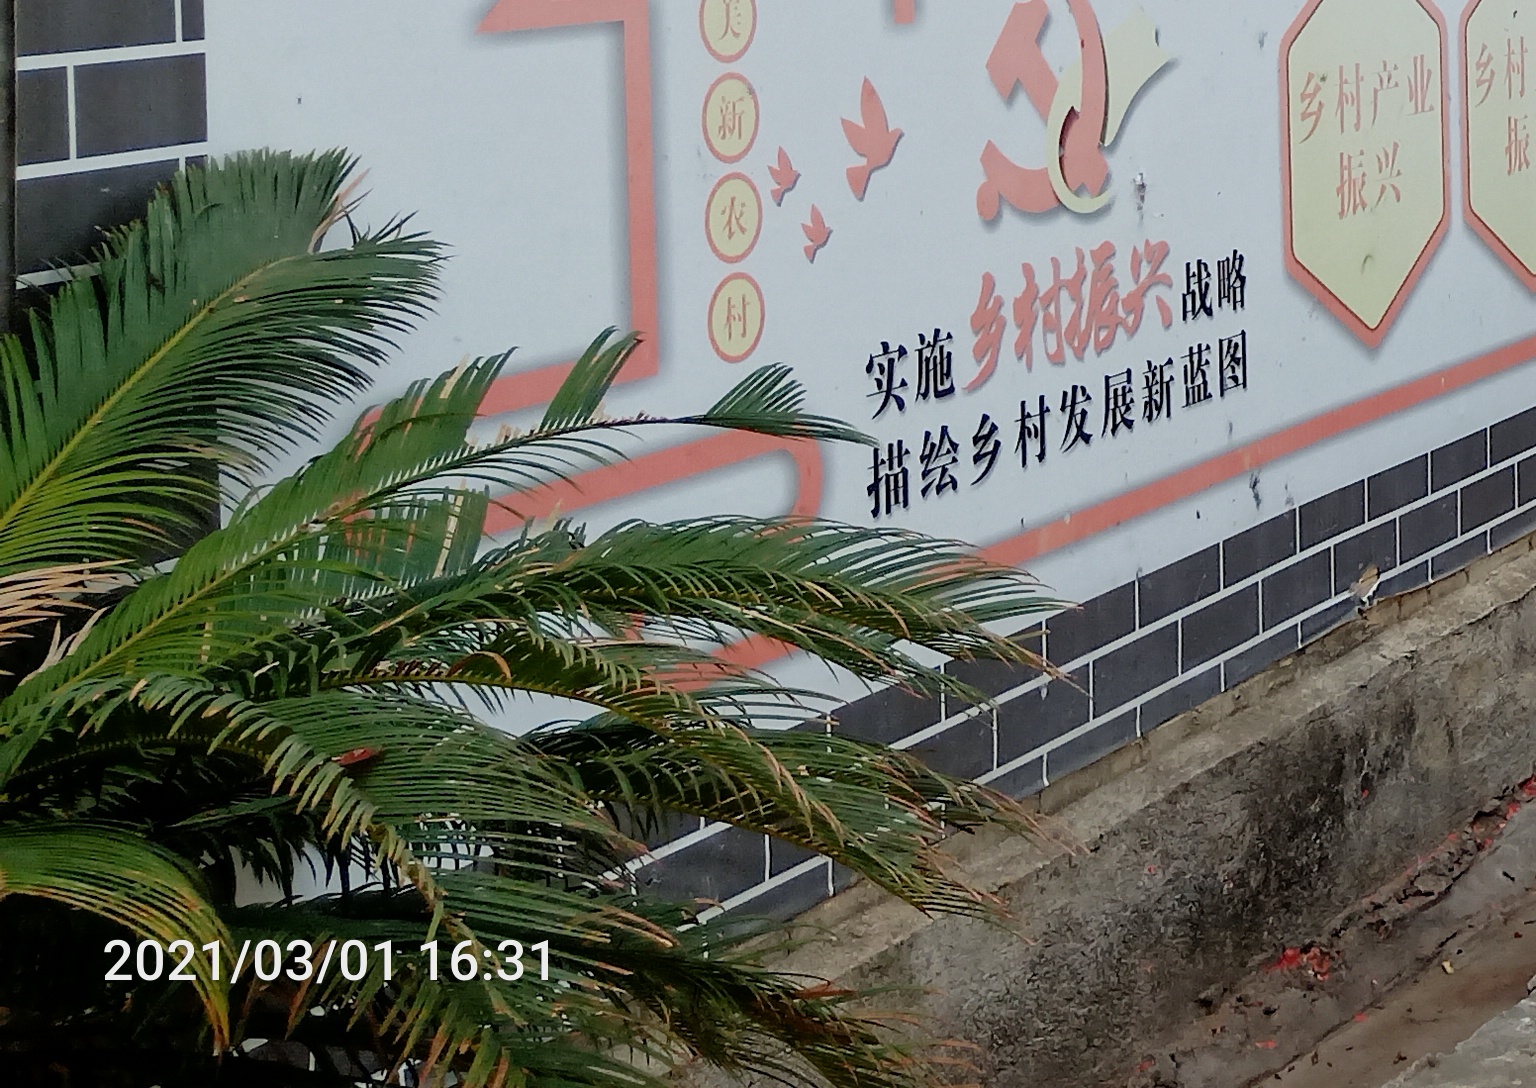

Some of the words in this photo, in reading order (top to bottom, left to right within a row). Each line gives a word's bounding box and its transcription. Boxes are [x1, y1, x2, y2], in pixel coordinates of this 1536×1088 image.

[1299, 53, 1436, 145] 乡村产业
[1335, 140, 1403, 220] 振兴
[866, 329, 1249, 519] 描绘乡村发展新蓝图
